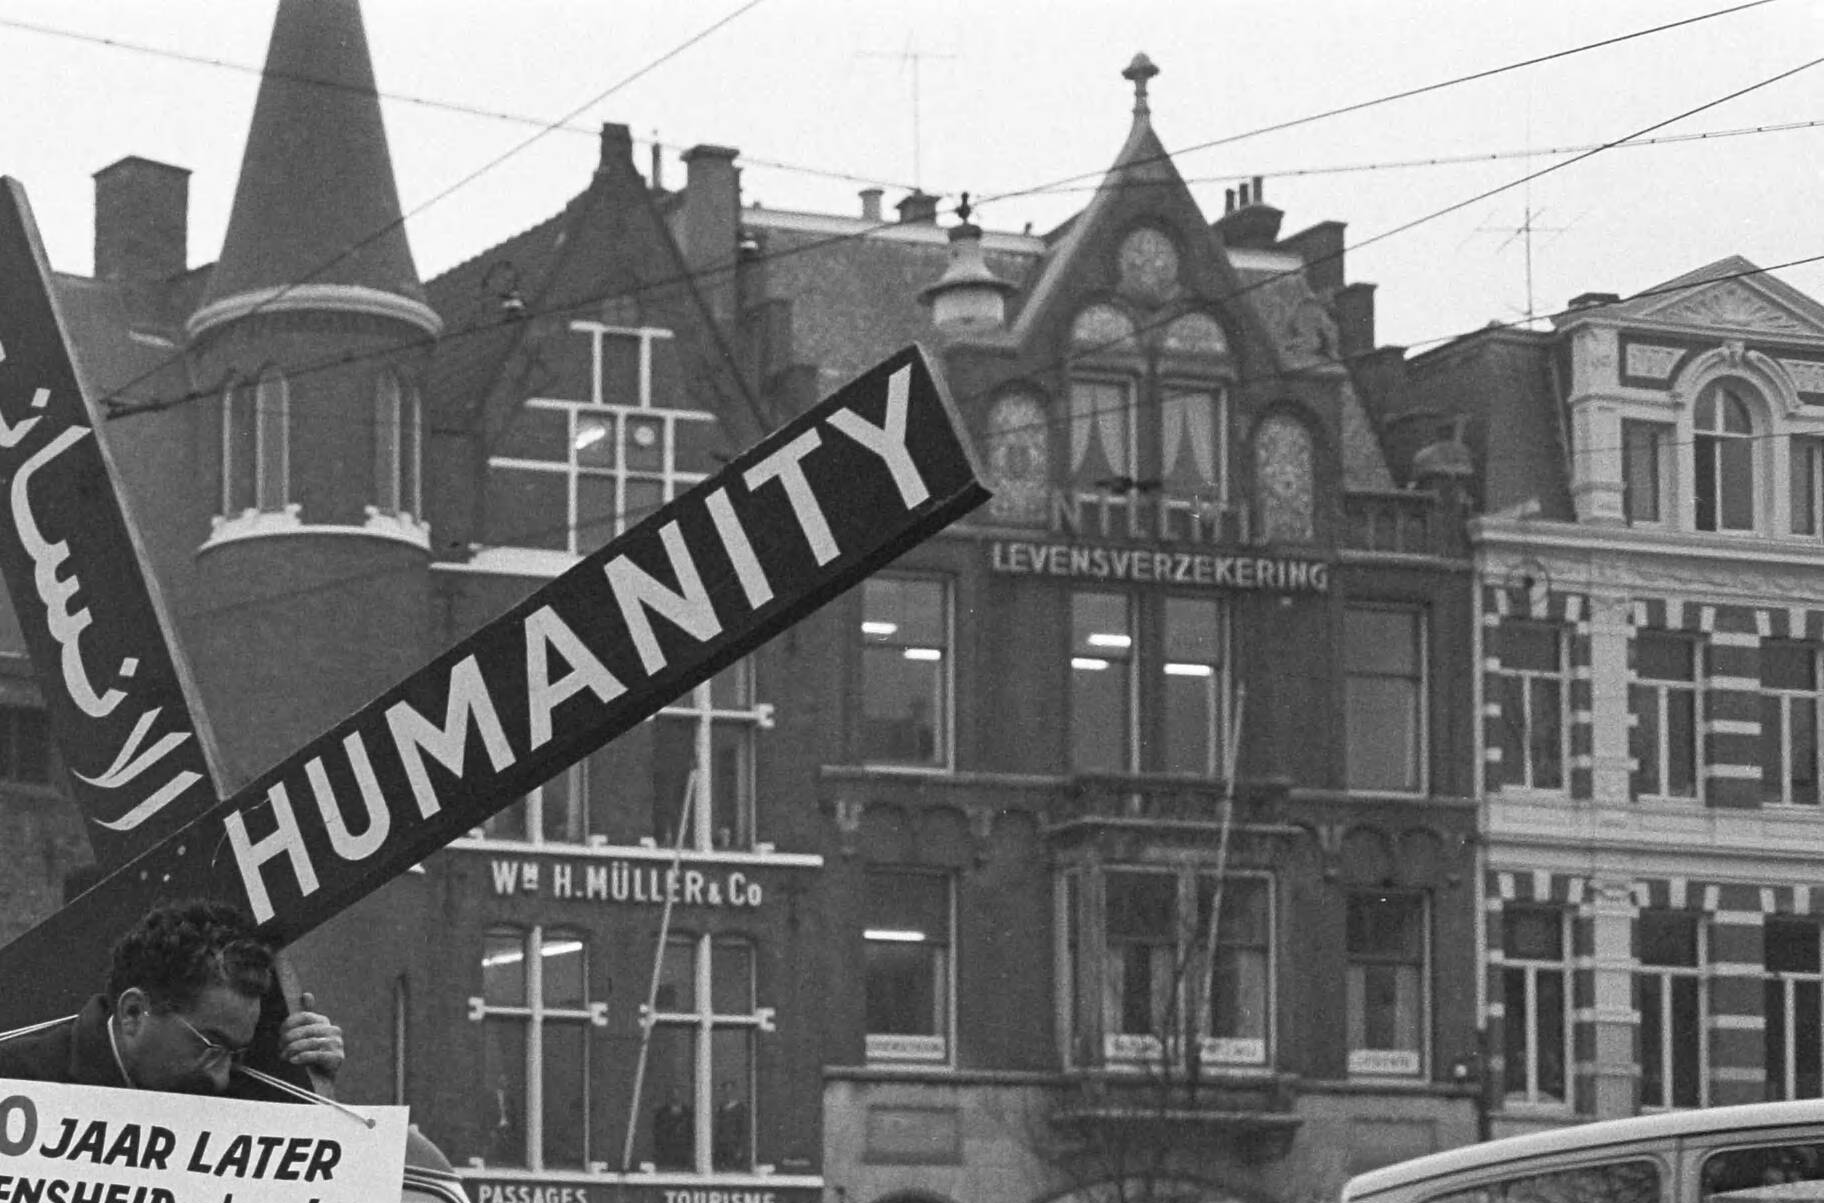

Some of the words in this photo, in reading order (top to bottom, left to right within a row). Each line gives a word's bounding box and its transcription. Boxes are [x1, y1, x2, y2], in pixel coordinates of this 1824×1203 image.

[991, 540, 1329, 592] LEVENSVERZEKERING
[223, 362, 932, 926] HUMANITY
[39, 1118, 176, 1170] JAAR
[187, 1131, 341, 1182] LATER
